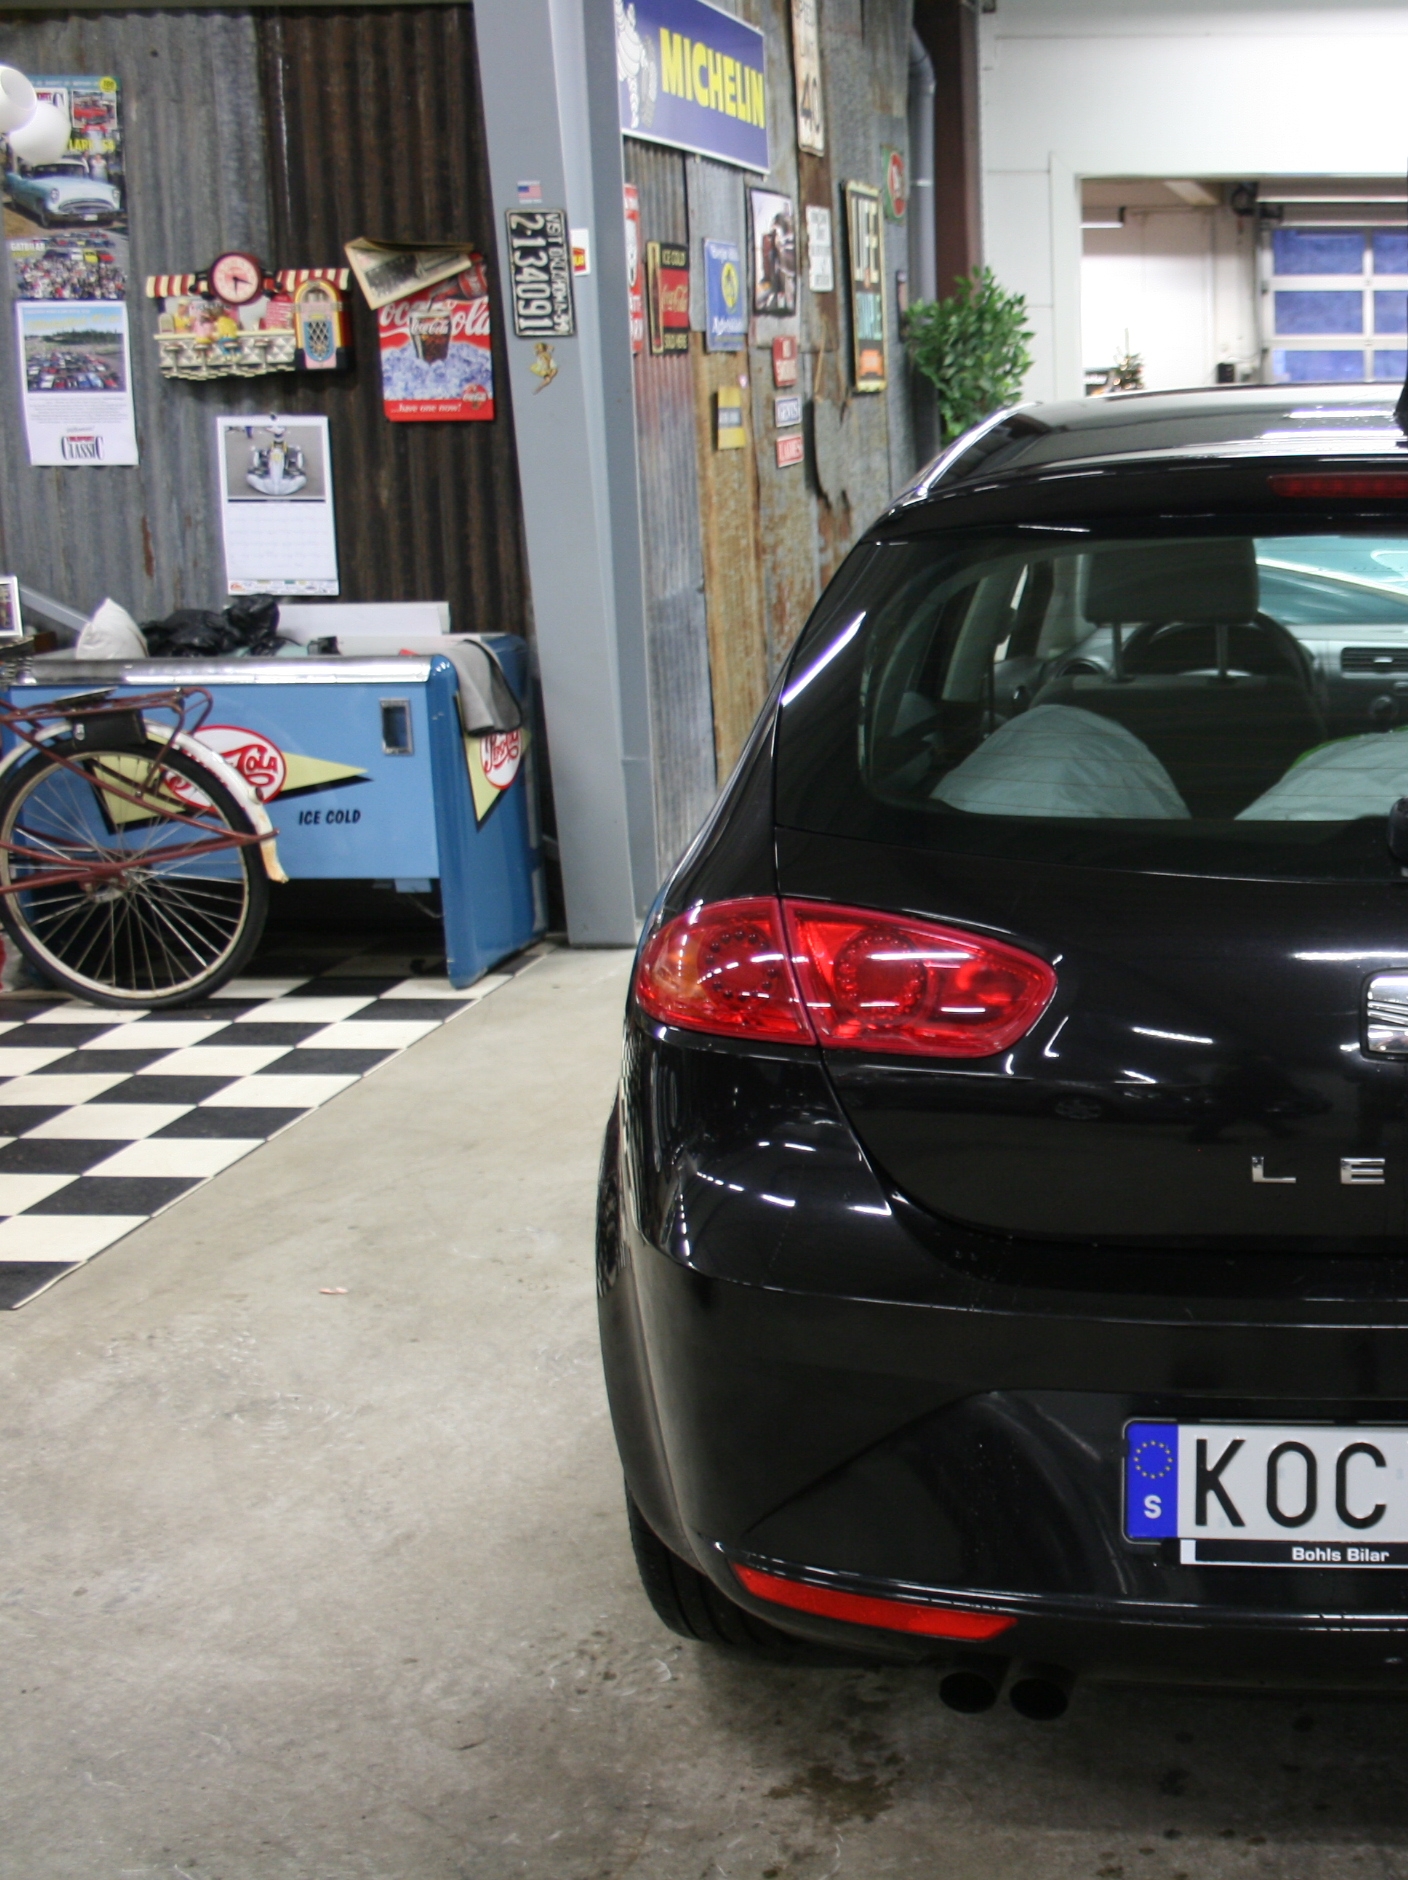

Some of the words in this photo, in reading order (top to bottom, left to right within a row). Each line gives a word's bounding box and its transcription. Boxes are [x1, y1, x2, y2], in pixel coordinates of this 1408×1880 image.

[660, 27, 766, 129] MICHELIN
[420, 404, 436, 412] one
[299, 810, 321, 826] ICE
[326, 809, 361, 824] COLD
[1194, 1438, 1388, 1530] KOC
[1143, 1494, 1163, 1519] S
[1291, 1546, 1342, 1562] Bohls
[1346, 1547, 1390, 1562] Bilar
